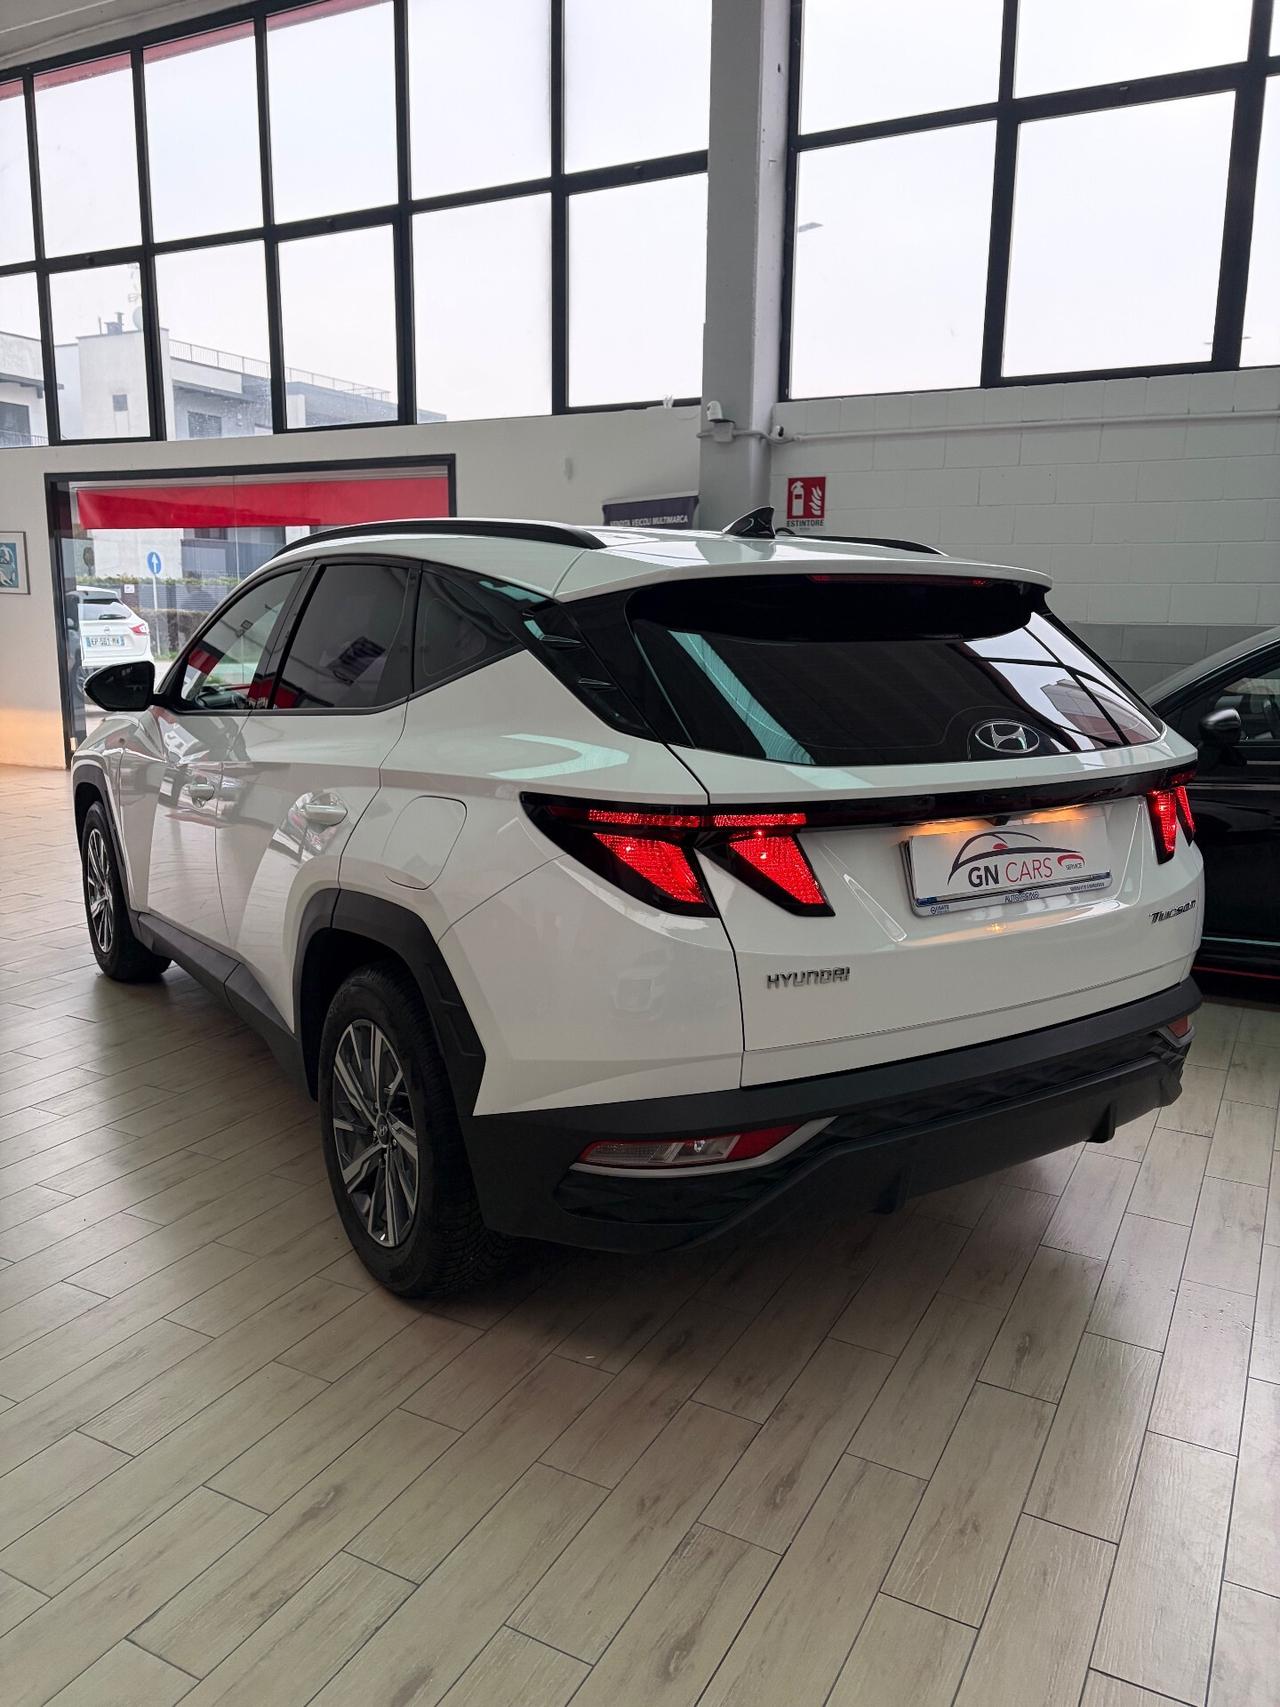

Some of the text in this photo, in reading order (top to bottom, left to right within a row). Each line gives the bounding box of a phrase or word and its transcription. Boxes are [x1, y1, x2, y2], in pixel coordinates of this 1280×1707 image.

[631, 517, 652, 527] VEICOLI
[652, 514, 689, 525] MULTIMARCA
[786, 519, 825, 528] ESTINTORE
[968, 857, 1053, 887] GN CARS
[766, 966, 850, 989] HYUNDAI
